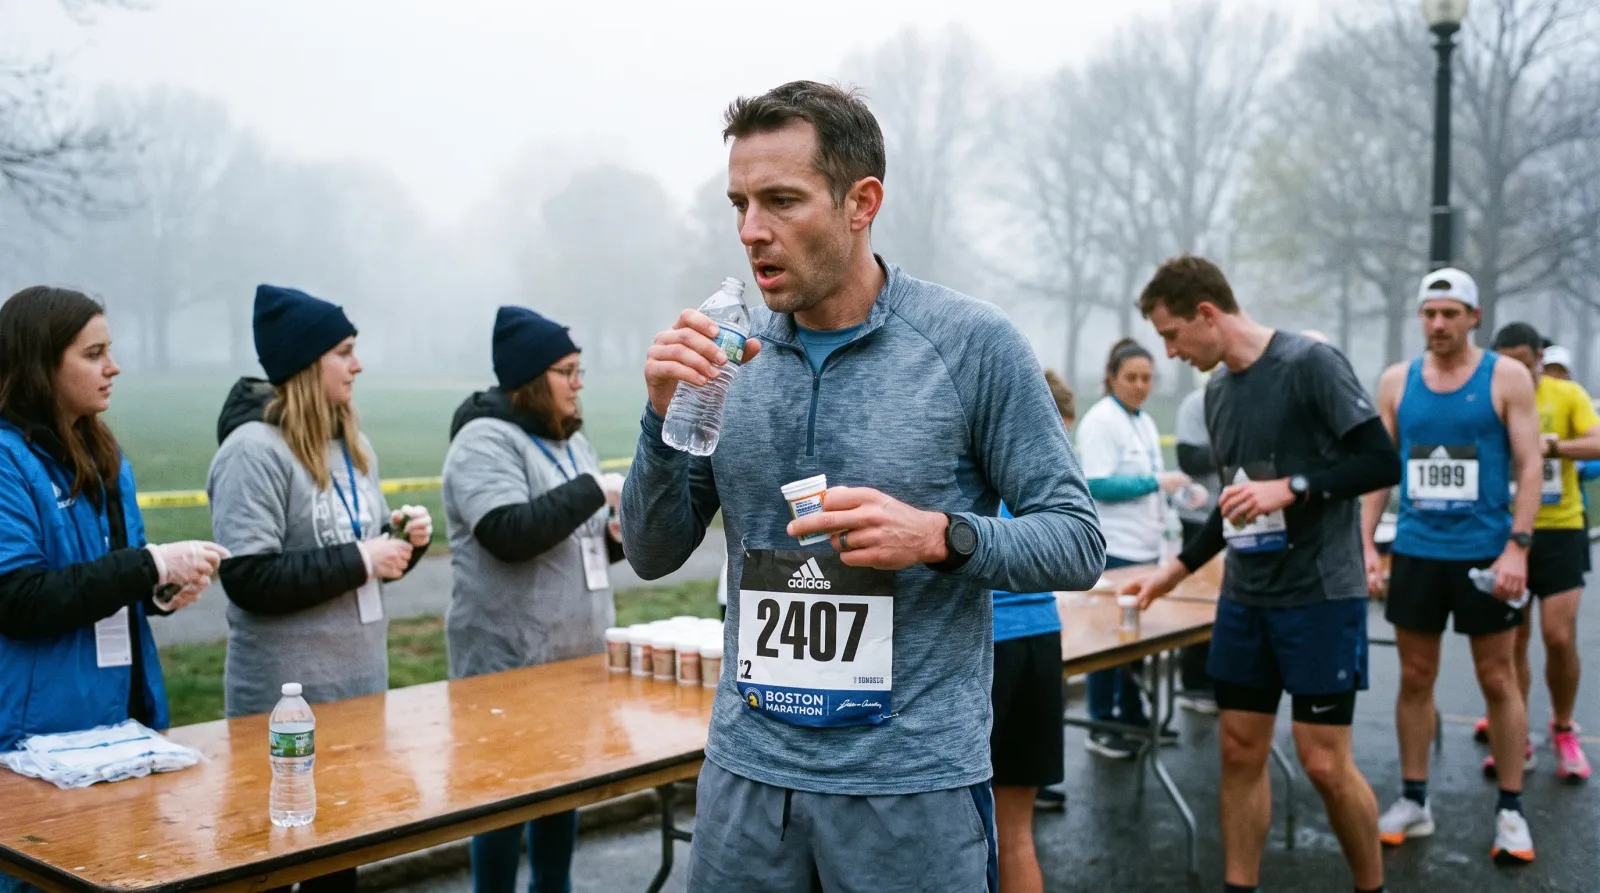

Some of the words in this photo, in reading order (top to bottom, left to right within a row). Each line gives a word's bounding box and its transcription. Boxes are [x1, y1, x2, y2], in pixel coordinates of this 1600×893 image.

[788, 577, 831, 590] adidas
[756, 598, 869, 662] 2407
[765, 691, 823, 706] BOSTON
[766, 703, 823, 716] MARATHON
